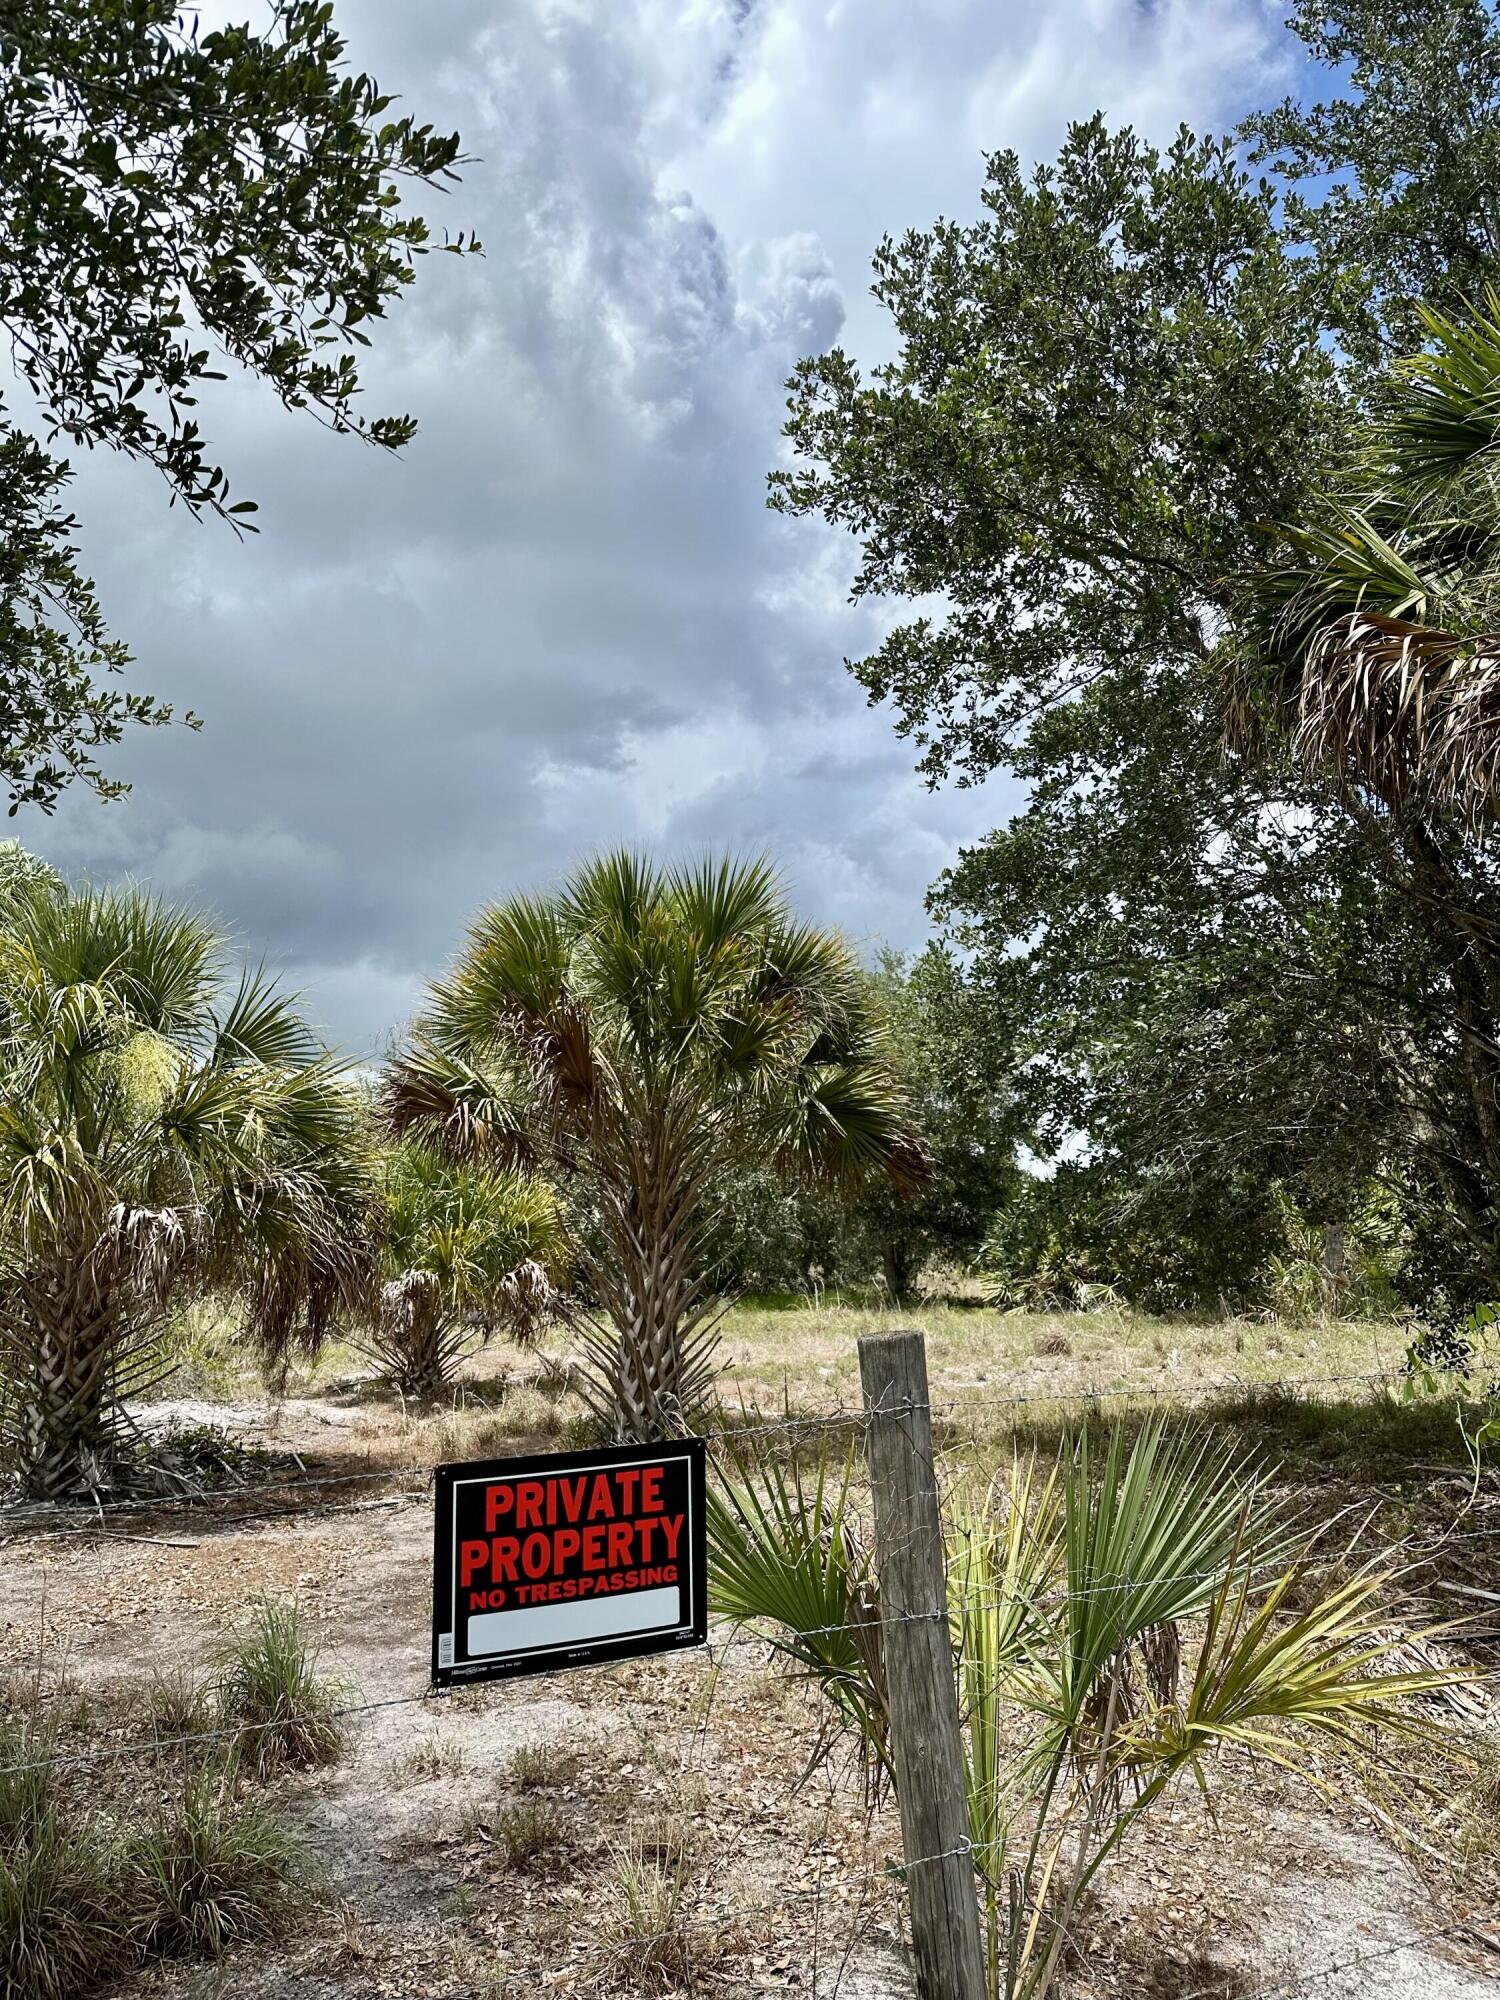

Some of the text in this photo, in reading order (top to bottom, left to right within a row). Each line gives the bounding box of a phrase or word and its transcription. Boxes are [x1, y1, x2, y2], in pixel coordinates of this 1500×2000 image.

[485, 1467, 664, 1533] PRIVATE
[461, 1514, 685, 1587] PROPERTY
[469, 1564, 678, 1611] NO TRESPASSING
